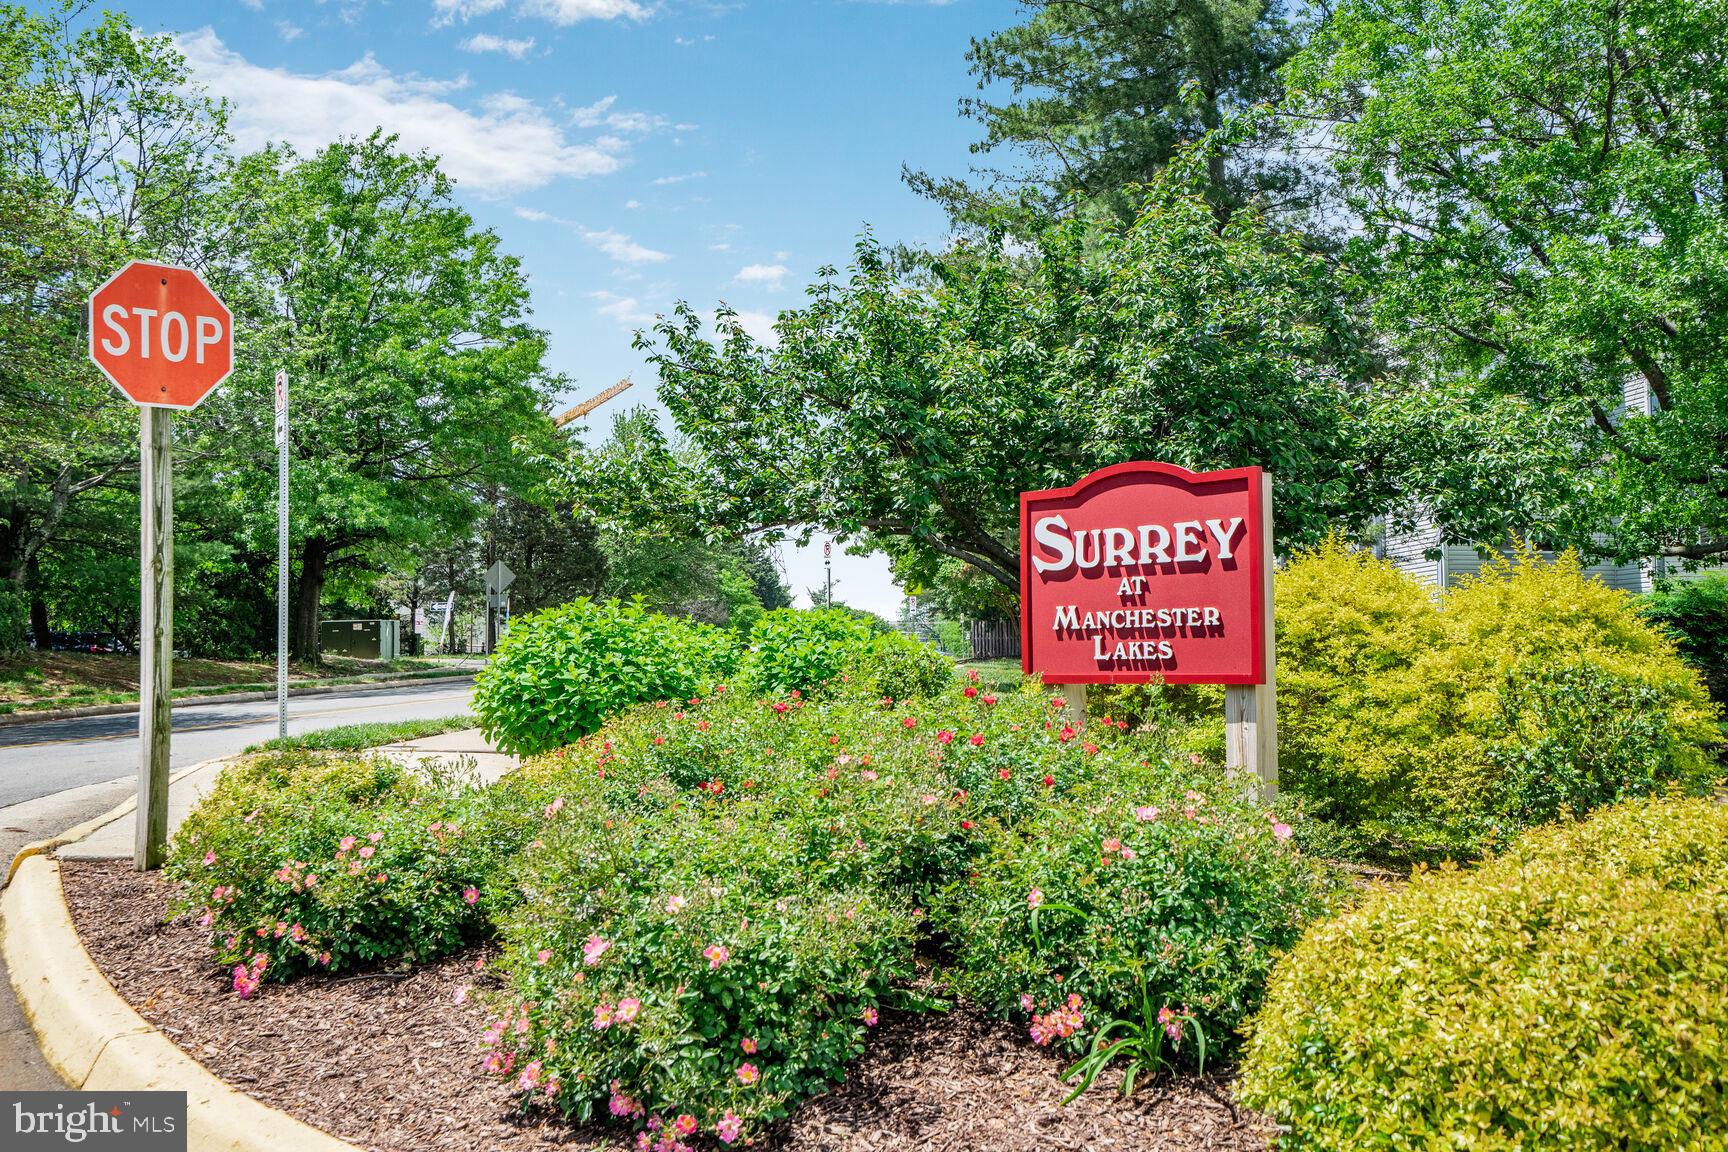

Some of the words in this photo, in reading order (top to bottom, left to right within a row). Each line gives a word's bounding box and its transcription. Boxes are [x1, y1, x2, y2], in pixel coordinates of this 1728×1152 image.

[101, 304, 223, 364] STOP
[1032, 514, 1243, 574] SURREY
[1117, 576, 1147, 596] AT
[1053, 606, 1221, 630] MANCHESTER
[1093, 635, 1174, 660] LAKES
